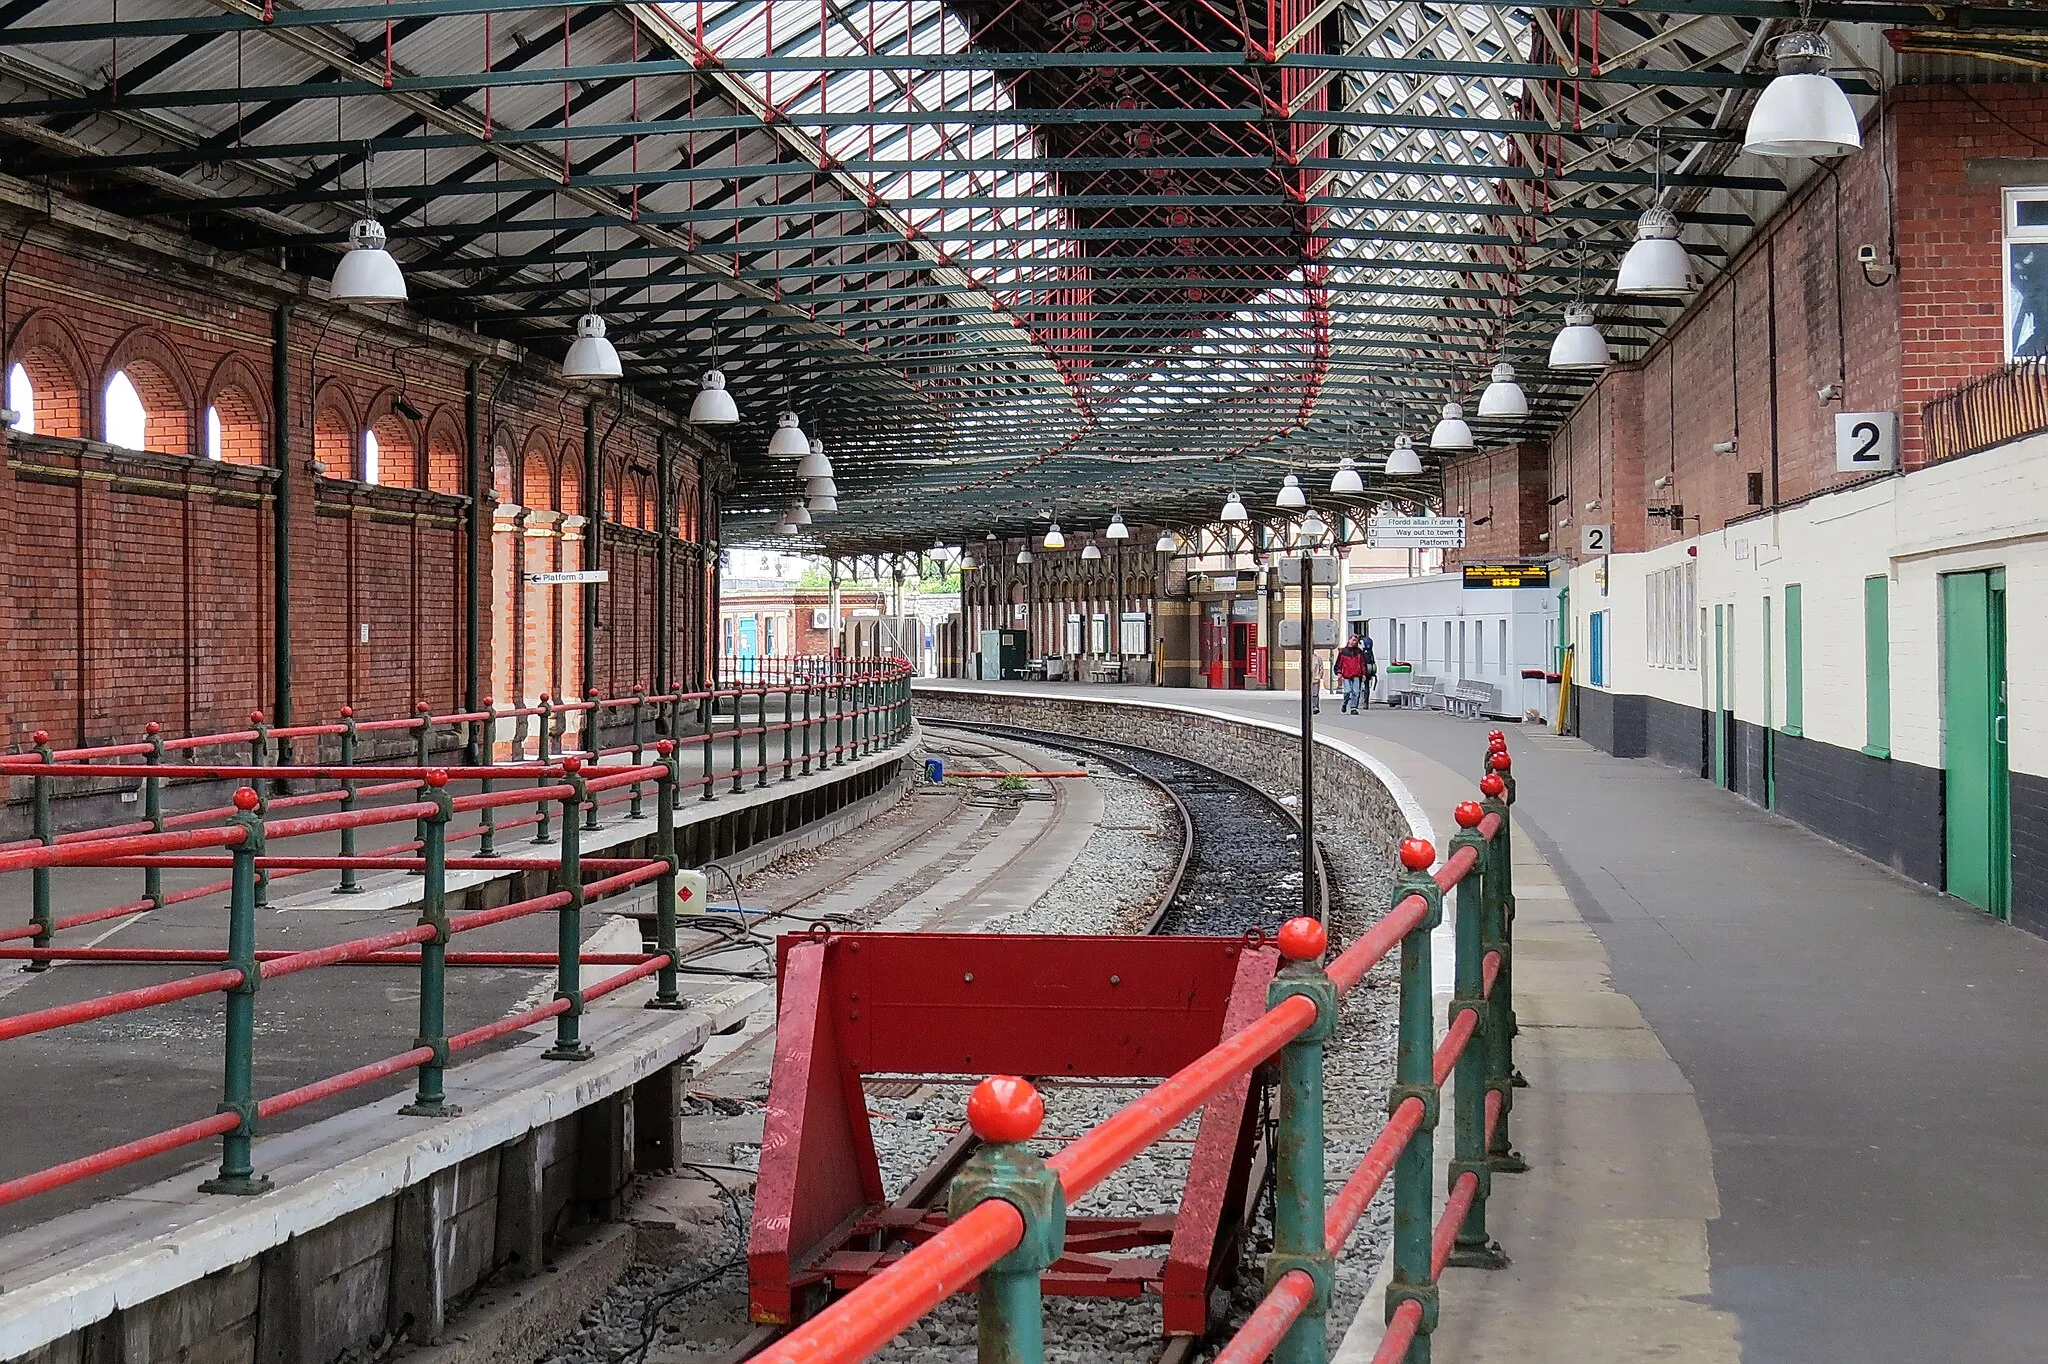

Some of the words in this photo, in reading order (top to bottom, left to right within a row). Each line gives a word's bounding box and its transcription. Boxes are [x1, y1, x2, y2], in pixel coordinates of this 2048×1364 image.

[1850, 421, 1881, 462] 2
[1396, 529, 1412, 537] Way
[1588, 529, 1604, 550] 2
[542, 573, 577, 582] Platform
[1020, 605, 1027, 614] 2
[1216, 616, 1222, 626] 1
